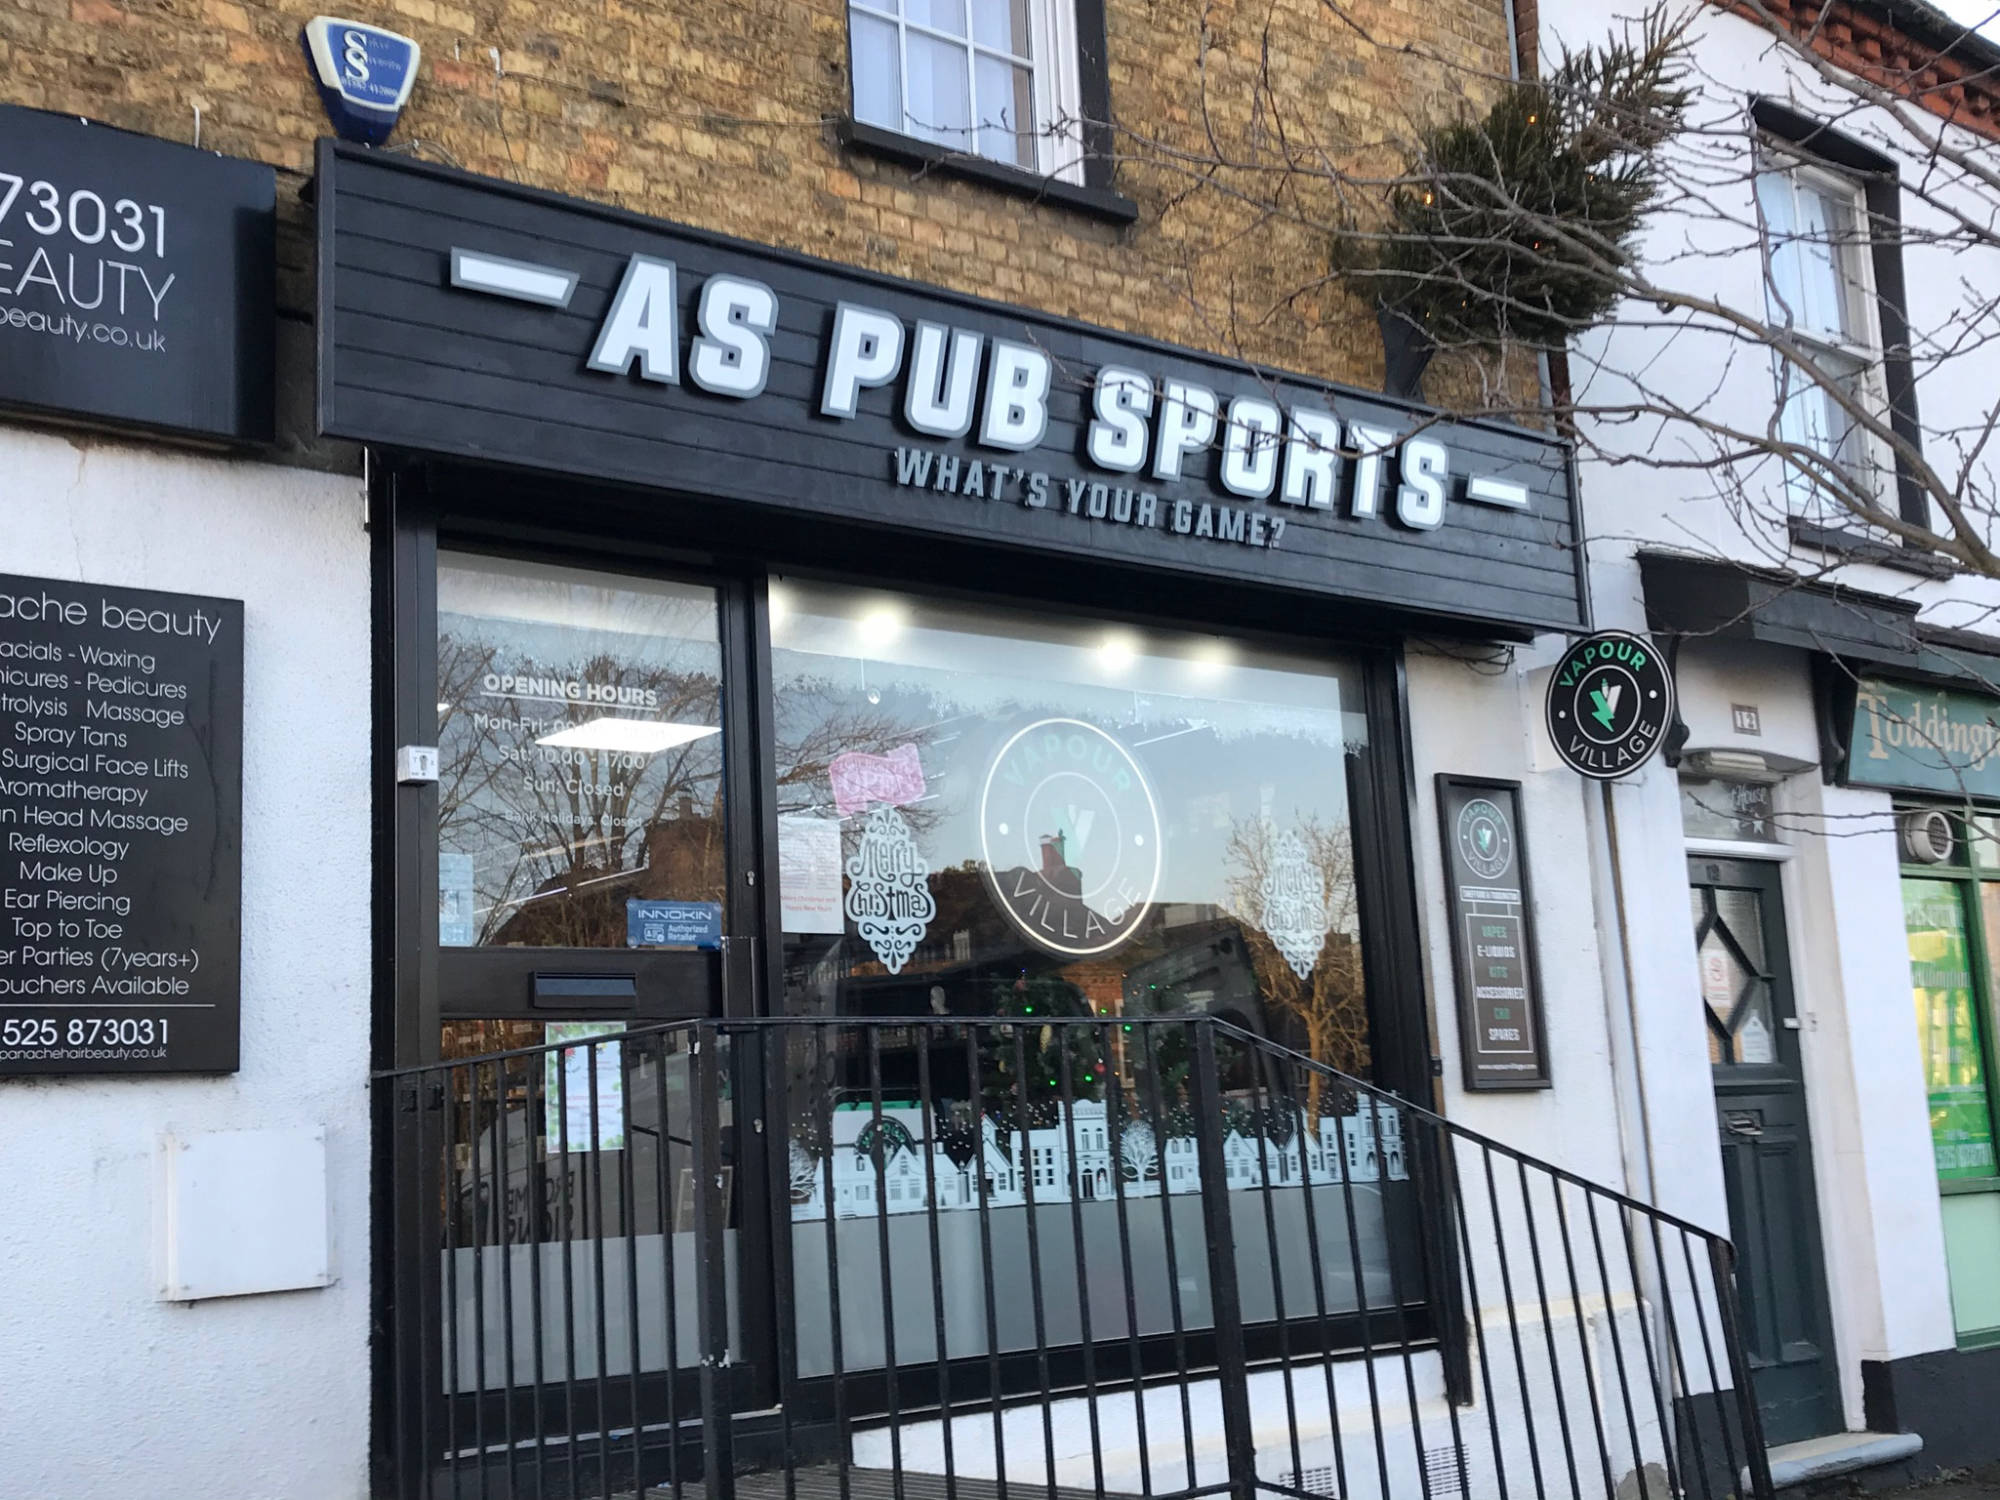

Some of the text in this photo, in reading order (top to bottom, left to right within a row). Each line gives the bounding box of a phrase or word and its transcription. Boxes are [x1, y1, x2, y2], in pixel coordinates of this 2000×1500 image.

[586, 252, 1449, 531] AS PUB SPORTS
[896, 447, 1286, 548] WHAT'S YOUR GAME?
[0, 592, 222, 645] ache beauty
[0, 640, 62, 662] acials
[79, 645, 156, 674] Waxing
[1560, 641, 1648, 689] VAPOUR
[87, 672, 187, 700] Pedicures
[483, 674, 657, 705] OPENING HOURS
[1, 693, 185, 728] trolysis Massage
[474, 713, 548, 733] Mon-Fri:
[15, 721, 127, 748] Spray Tans
[1568, 719, 1658, 769] VILLAGE
[1856, 691, 2000, 771] Toddingt
[1, 748, 189, 779] Surgical Face Lifts
[1002, 734, 1132, 793] VAPOUR
[566, 780, 624, 798] Closed
[24, 805, 83, 827] Head
[90, 808, 189, 836] Massage
[504, 809, 537, 822] Bank
[600, 815, 642, 828] Closed
[1463, 803, 1502, 825] VAPOUR
[9, 832, 130, 860] Reflexology
[19, 861, 118, 887] Make Up
[852, 839, 926, 887] Merry
[4, 889, 131, 916] Ear Piercing
[638, 909, 712, 920] INNOKIN
[850, 881, 932, 921] Christmas
[1013, 871, 1142, 940] VILLAGE
[12, 917, 123, 941] Top to Toe
[667, 924, 709, 934] Authorized
[667, 933, 697, 942] Retailer
[22, 946, 94, 967] Parties
[101, 947, 199, 973] (7years+)
[91, 975, 189, 995] Available
[2, 1019, 168, 1046] 525 873031
